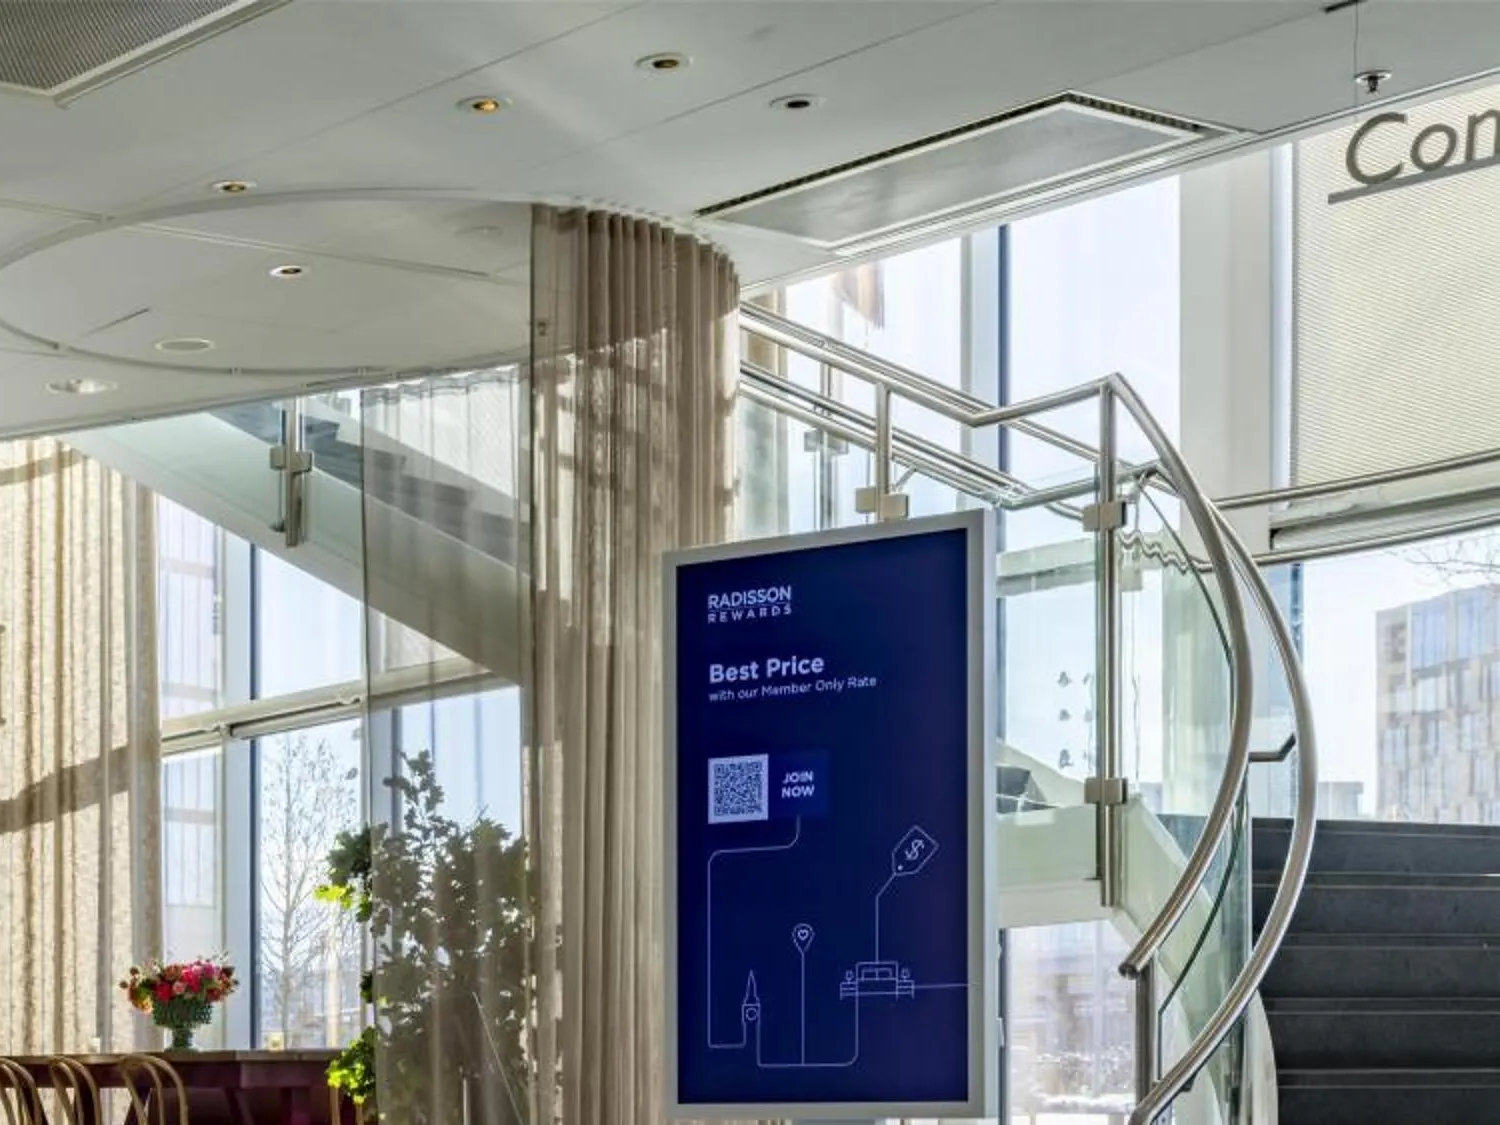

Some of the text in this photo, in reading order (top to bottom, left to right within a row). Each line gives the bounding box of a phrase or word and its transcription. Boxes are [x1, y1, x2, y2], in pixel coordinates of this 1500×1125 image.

[707, 585, 792, 610] RADISSON
[707, 604, 792, 624] REWARDS
[709, 655, 825, 683] Best Price
[708, 675, 878, 702] with our Member Only Rate
[782, 770, 815, 786] JOIN
[781, 784, 815, 798] NOW
